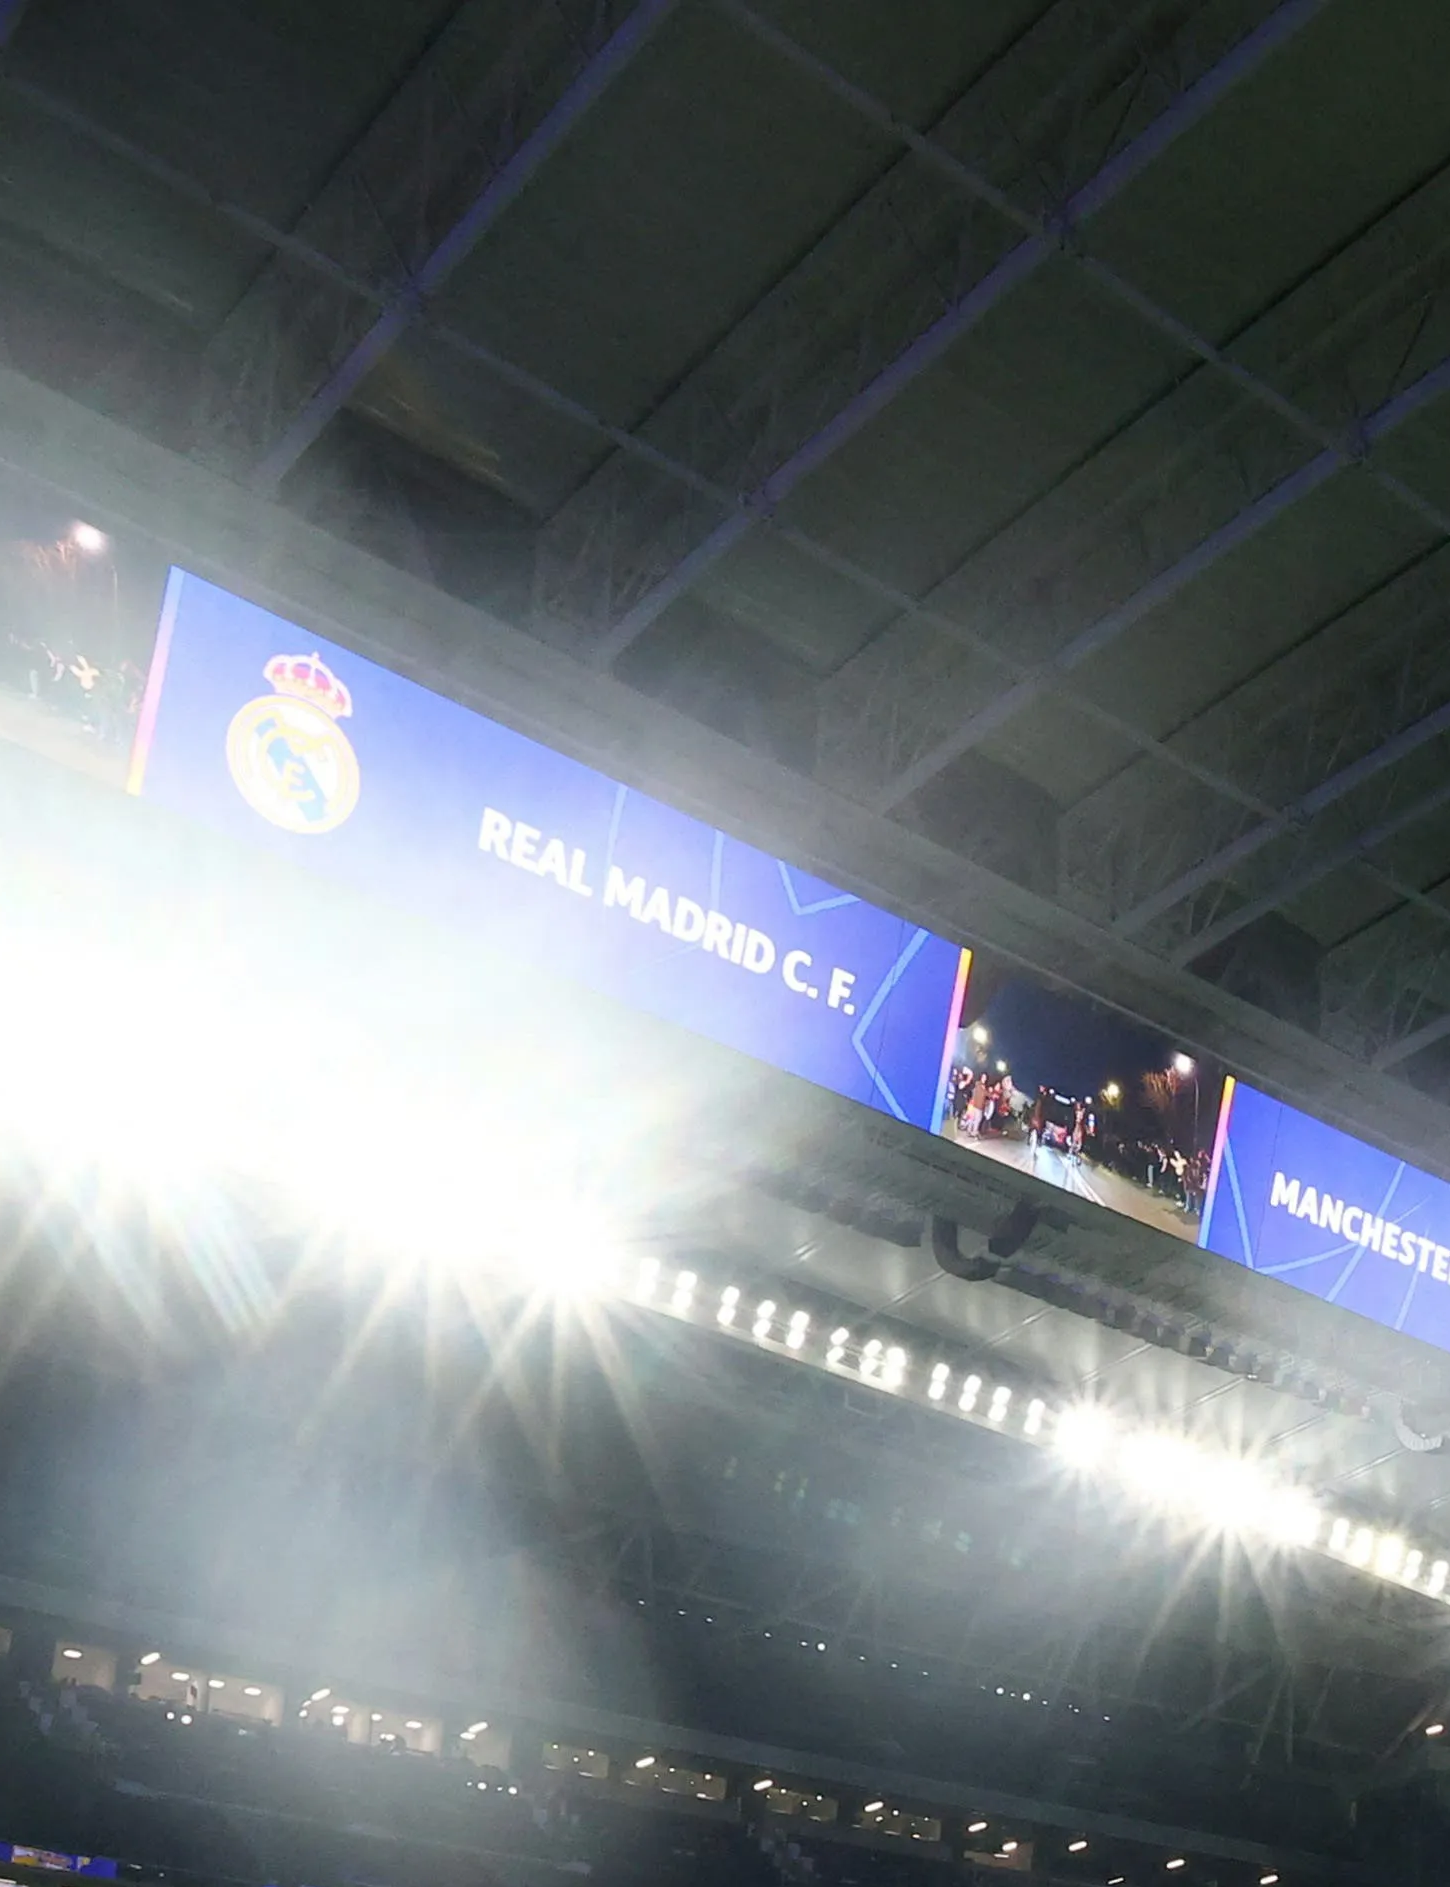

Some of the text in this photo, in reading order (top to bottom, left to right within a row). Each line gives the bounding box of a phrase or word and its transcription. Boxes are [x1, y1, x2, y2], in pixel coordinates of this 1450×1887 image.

[478, 806, 856, 1016] REAL MADRID C. F.
